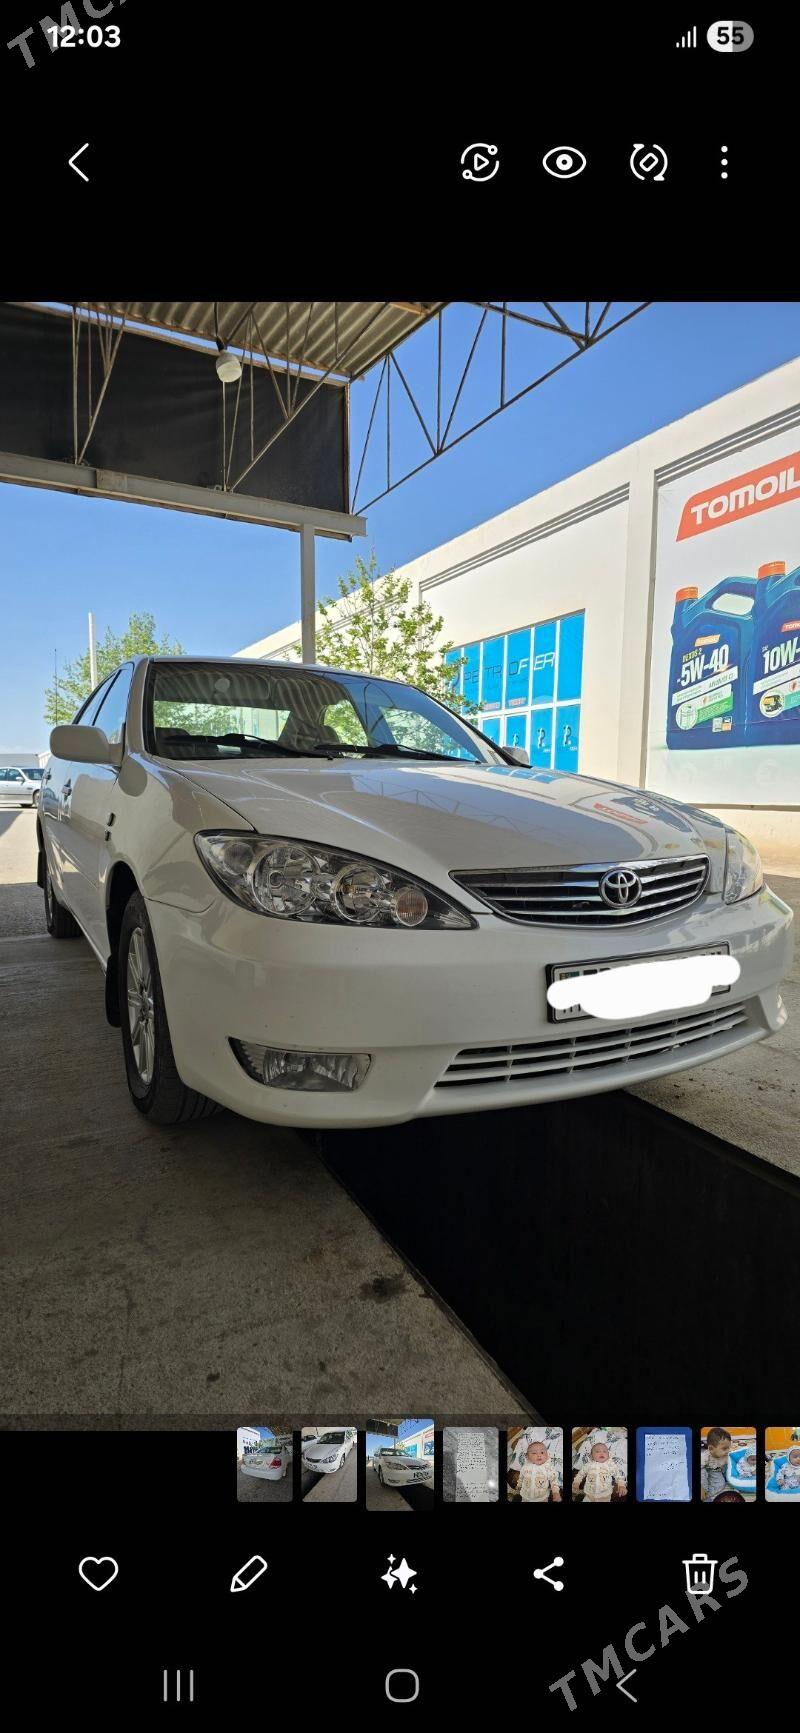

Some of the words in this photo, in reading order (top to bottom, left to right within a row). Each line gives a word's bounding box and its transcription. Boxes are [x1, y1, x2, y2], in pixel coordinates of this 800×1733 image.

[47, 25, 121, 48] 12:03
[717, 27, 744, 45] 55
[690, 466, 800, 525] TOMOIL
[464, 652, 556, 684] PETROFER
[681, 644, 730, 687] 5W-40
